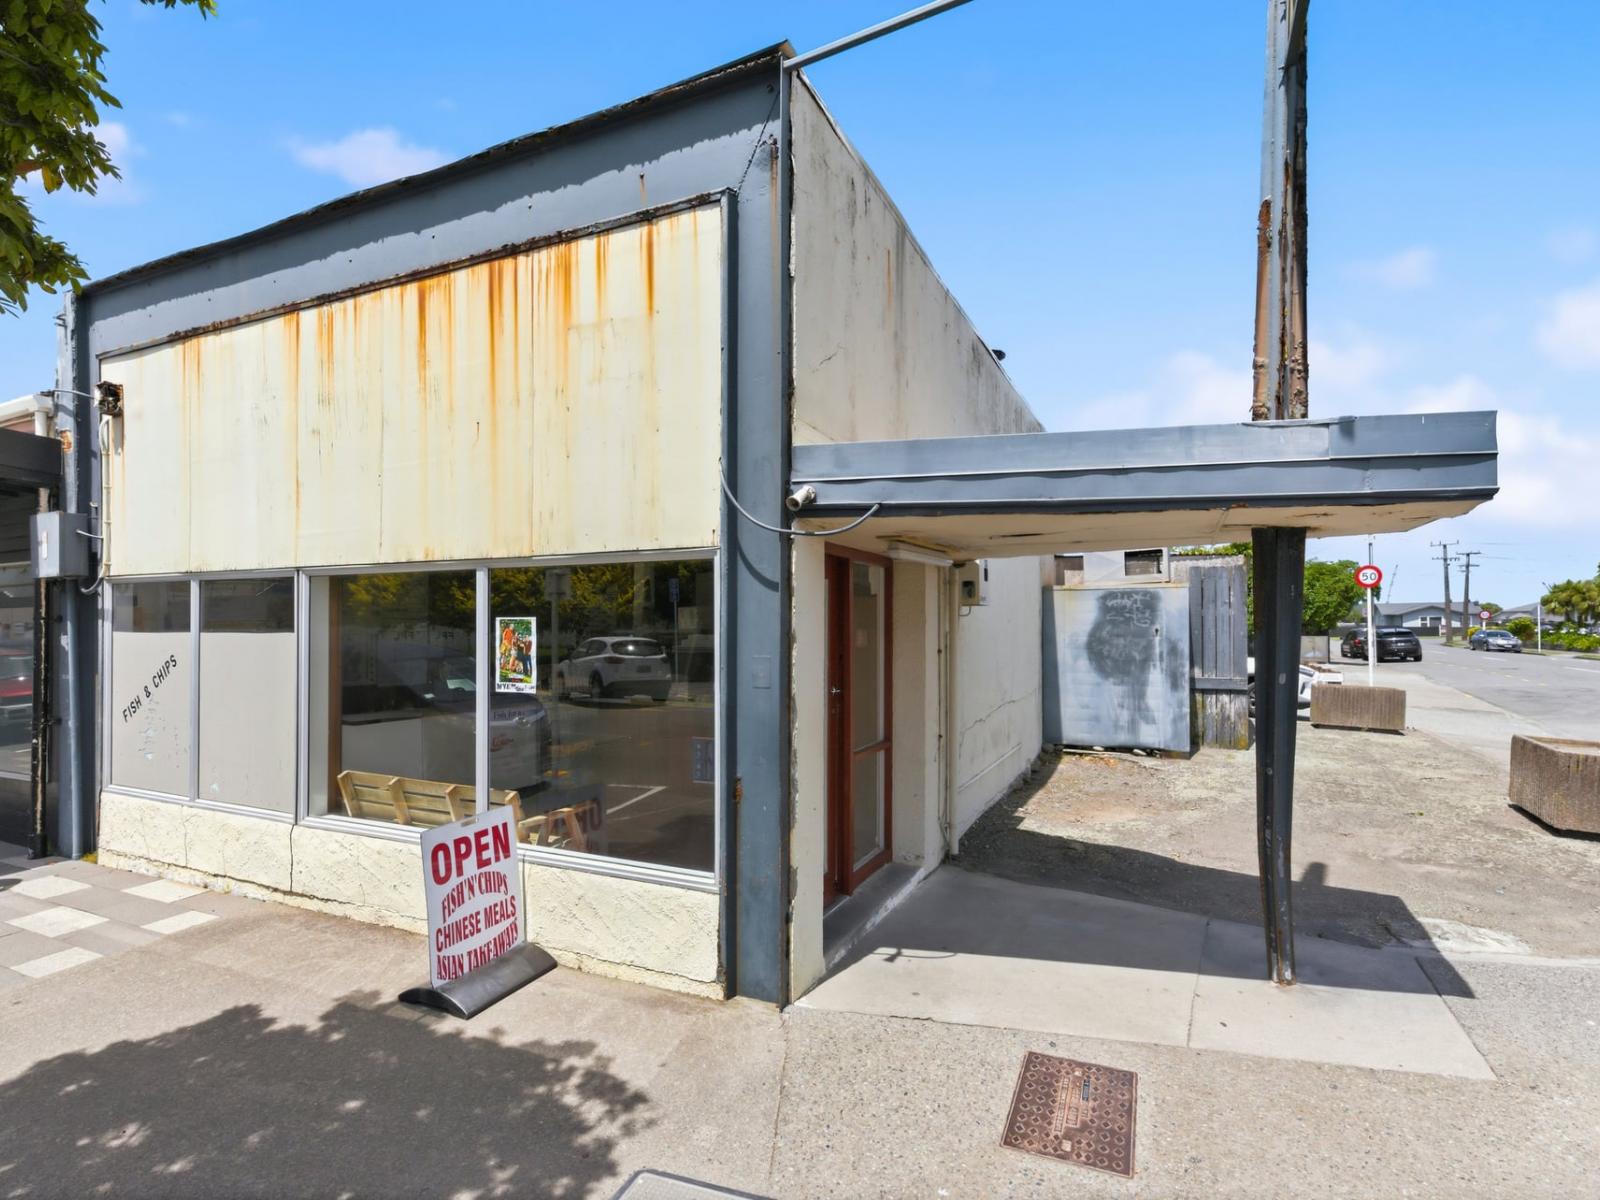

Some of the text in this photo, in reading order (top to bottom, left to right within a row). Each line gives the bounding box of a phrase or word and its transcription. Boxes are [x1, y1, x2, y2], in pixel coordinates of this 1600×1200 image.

[1362, 572, 1377, 581] 50
[122, 654, 177, 723] FISH & CHIPS
[431, 822, 511, 886] OPEN
[435, 895, 516, 952] CHINESE MEALS
[436, 953, 464, 980] ASIAN
